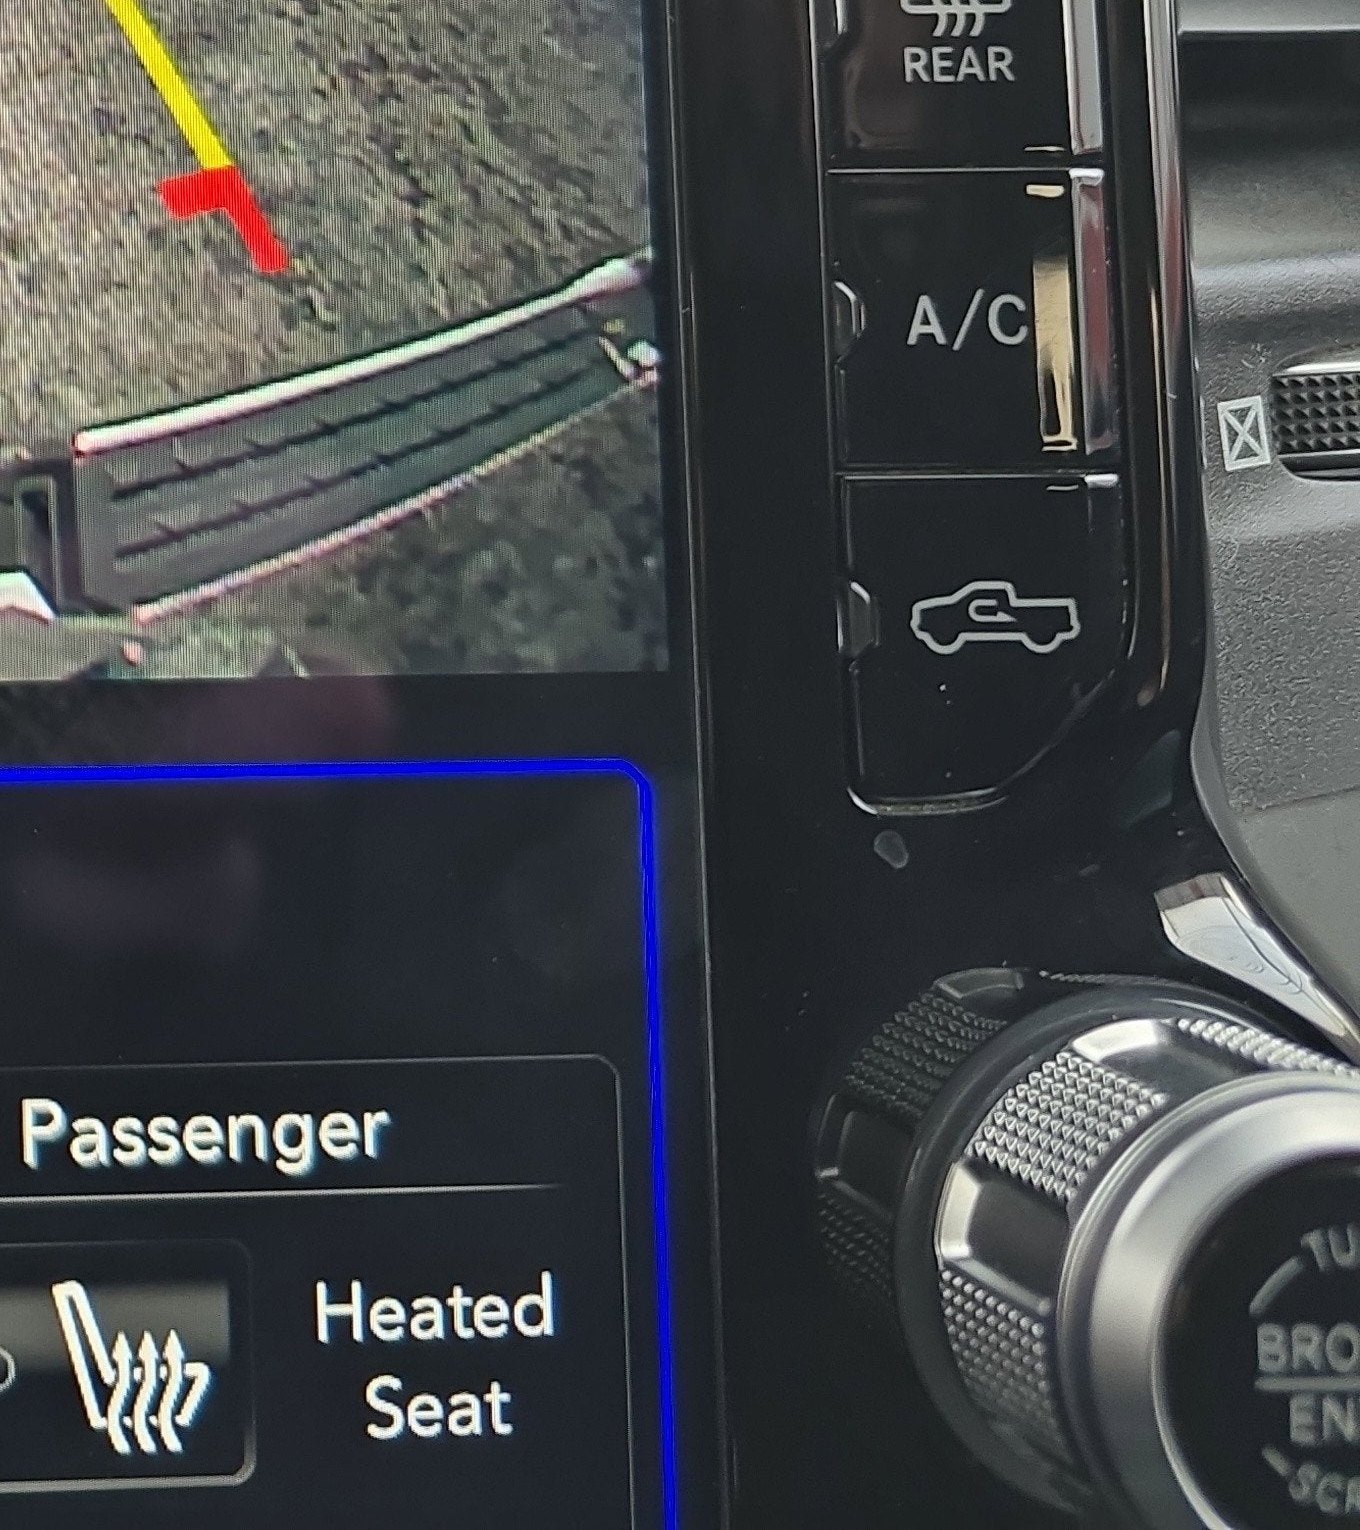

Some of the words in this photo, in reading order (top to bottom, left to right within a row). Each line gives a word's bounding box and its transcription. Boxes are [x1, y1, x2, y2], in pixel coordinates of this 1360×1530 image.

[903, 46, 1015, 83] REAR
[907, 288, 1028, 351] A/C
[22, 1098, 391, 1176] Passenger
[316, 1270, 555, 1343] Heated
[1256, 1322, 1360, 1373] BRO
[365, 1375, 514, 1440] Seat
